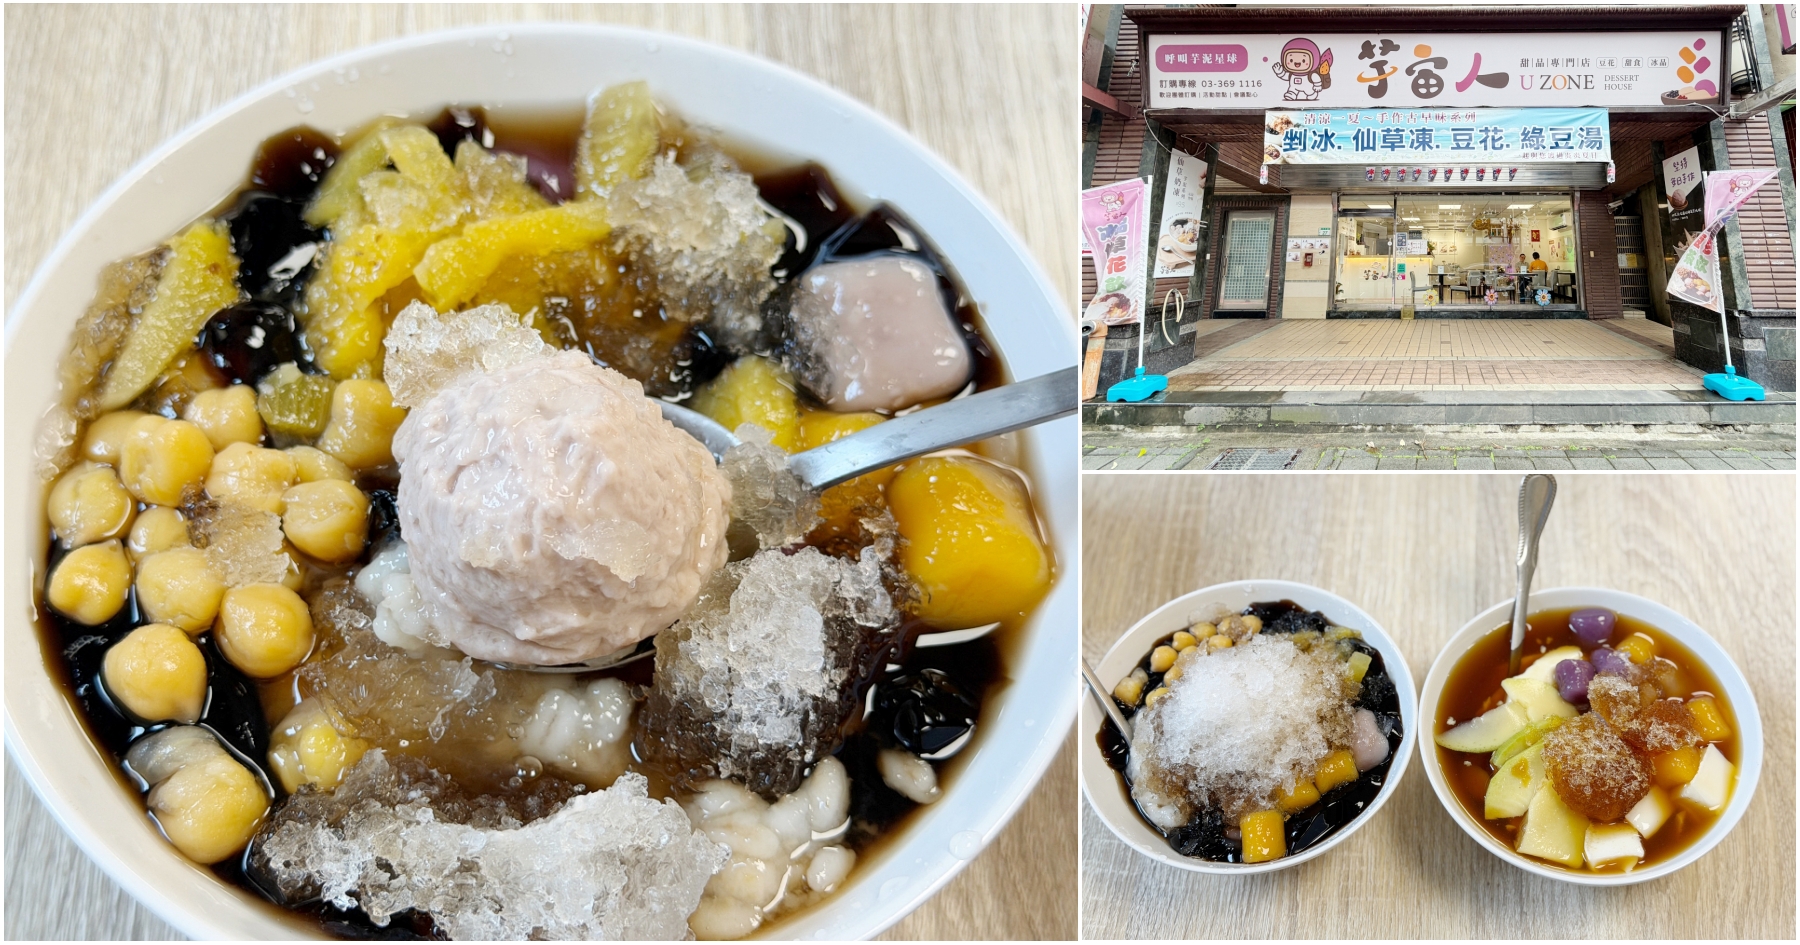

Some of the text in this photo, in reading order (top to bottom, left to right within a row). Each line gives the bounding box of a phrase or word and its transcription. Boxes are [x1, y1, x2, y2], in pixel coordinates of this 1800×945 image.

[1164, 53, 1238, 65] 呼叫芋泥星球
[1599, 59, 1667, 67] 豆花 甜食 冰品
[1357, 39, 1509, 99] 芋宙人
[1159, 79, 1263, 88] 訂購專線 03-369 1116
[1519, 75, 1595, 90] U ZONE
[1520, 126, 1604, 151] 綠豆湯
